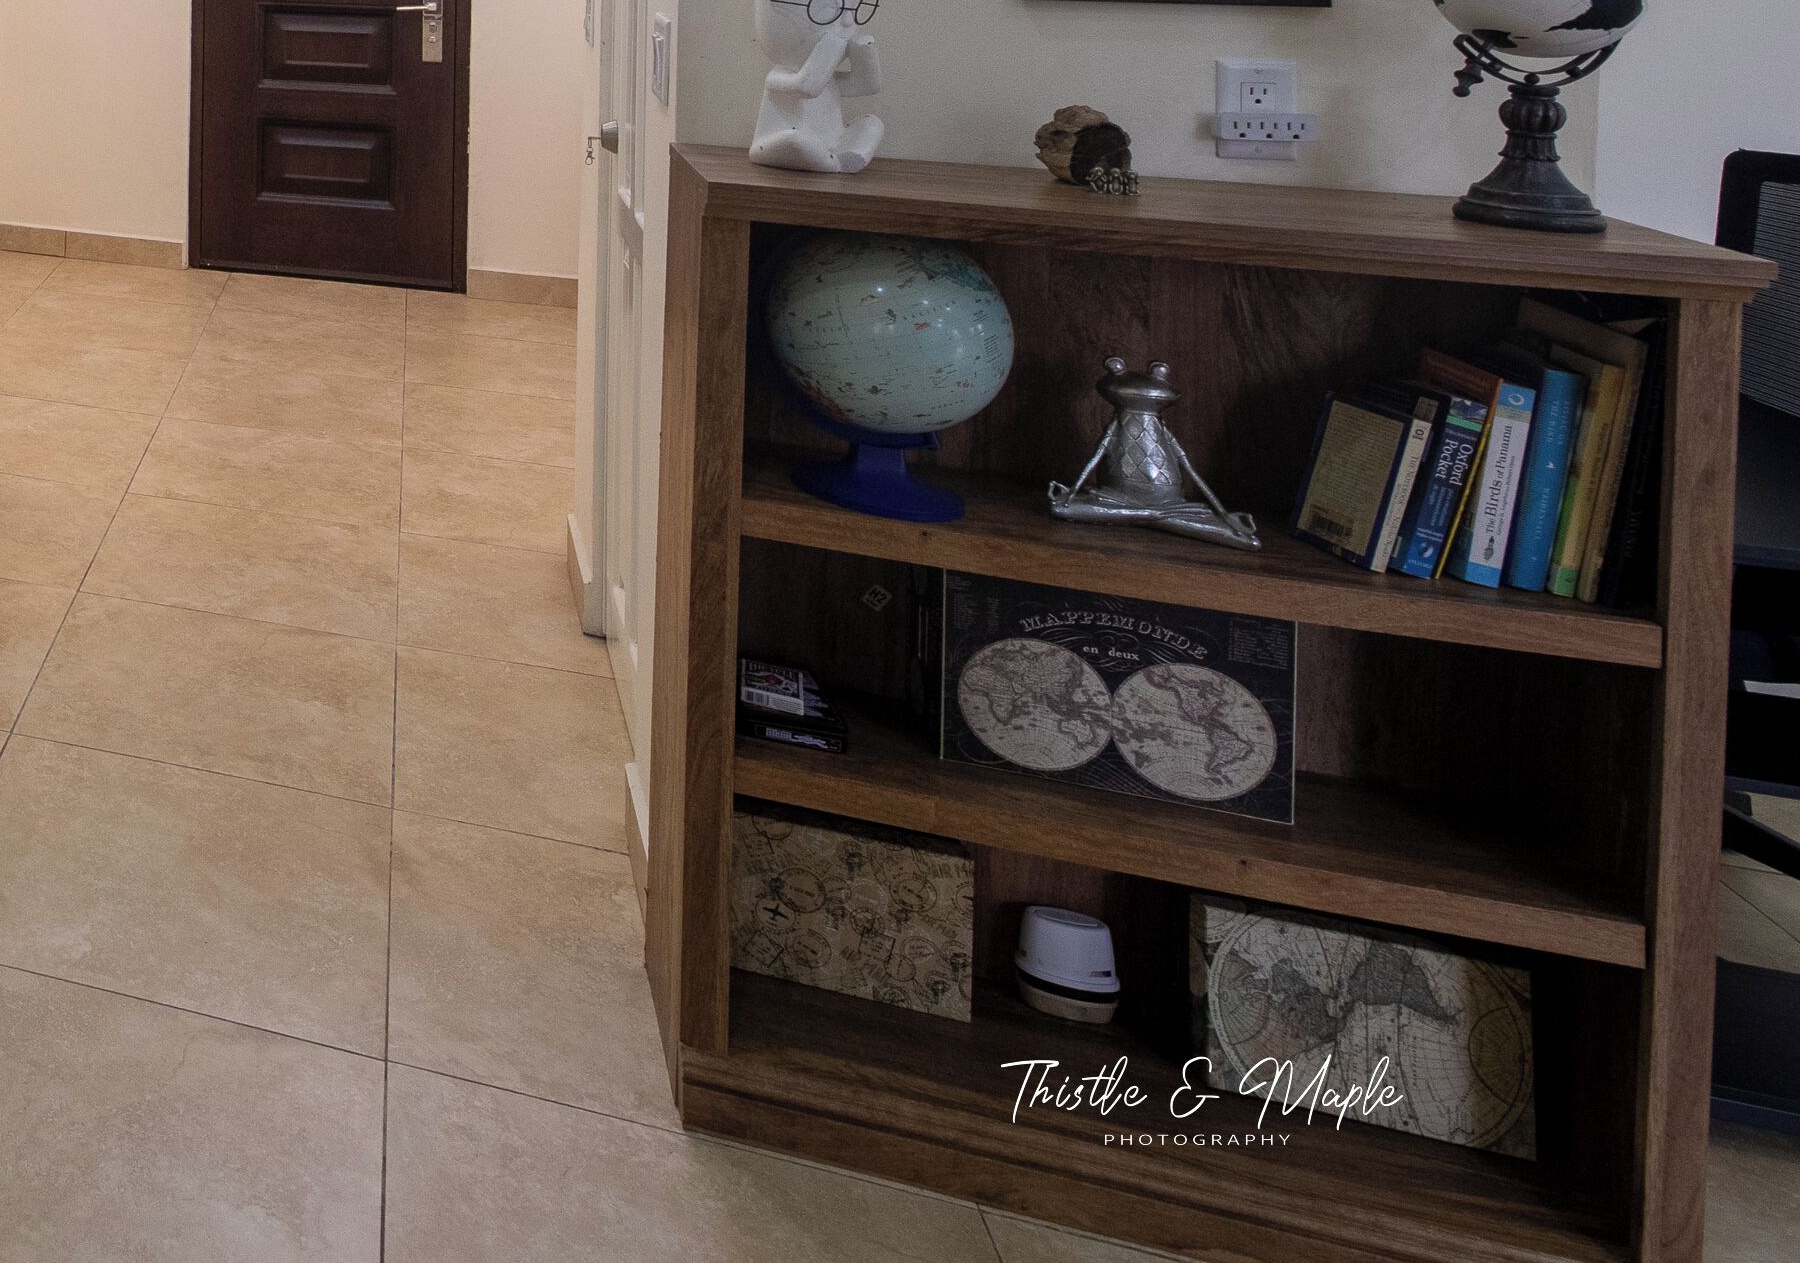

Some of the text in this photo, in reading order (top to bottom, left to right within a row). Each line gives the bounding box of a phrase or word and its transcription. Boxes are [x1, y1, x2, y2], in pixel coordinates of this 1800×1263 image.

[1435, 439, 1458, 480] Pocket
[1450, 444, 1474, 486] Oxford
[1485, 479, 1501, 517] Birds
[1495, 425, 1512, 469] Panama
[1083, 645, 1140, 661] en deux
